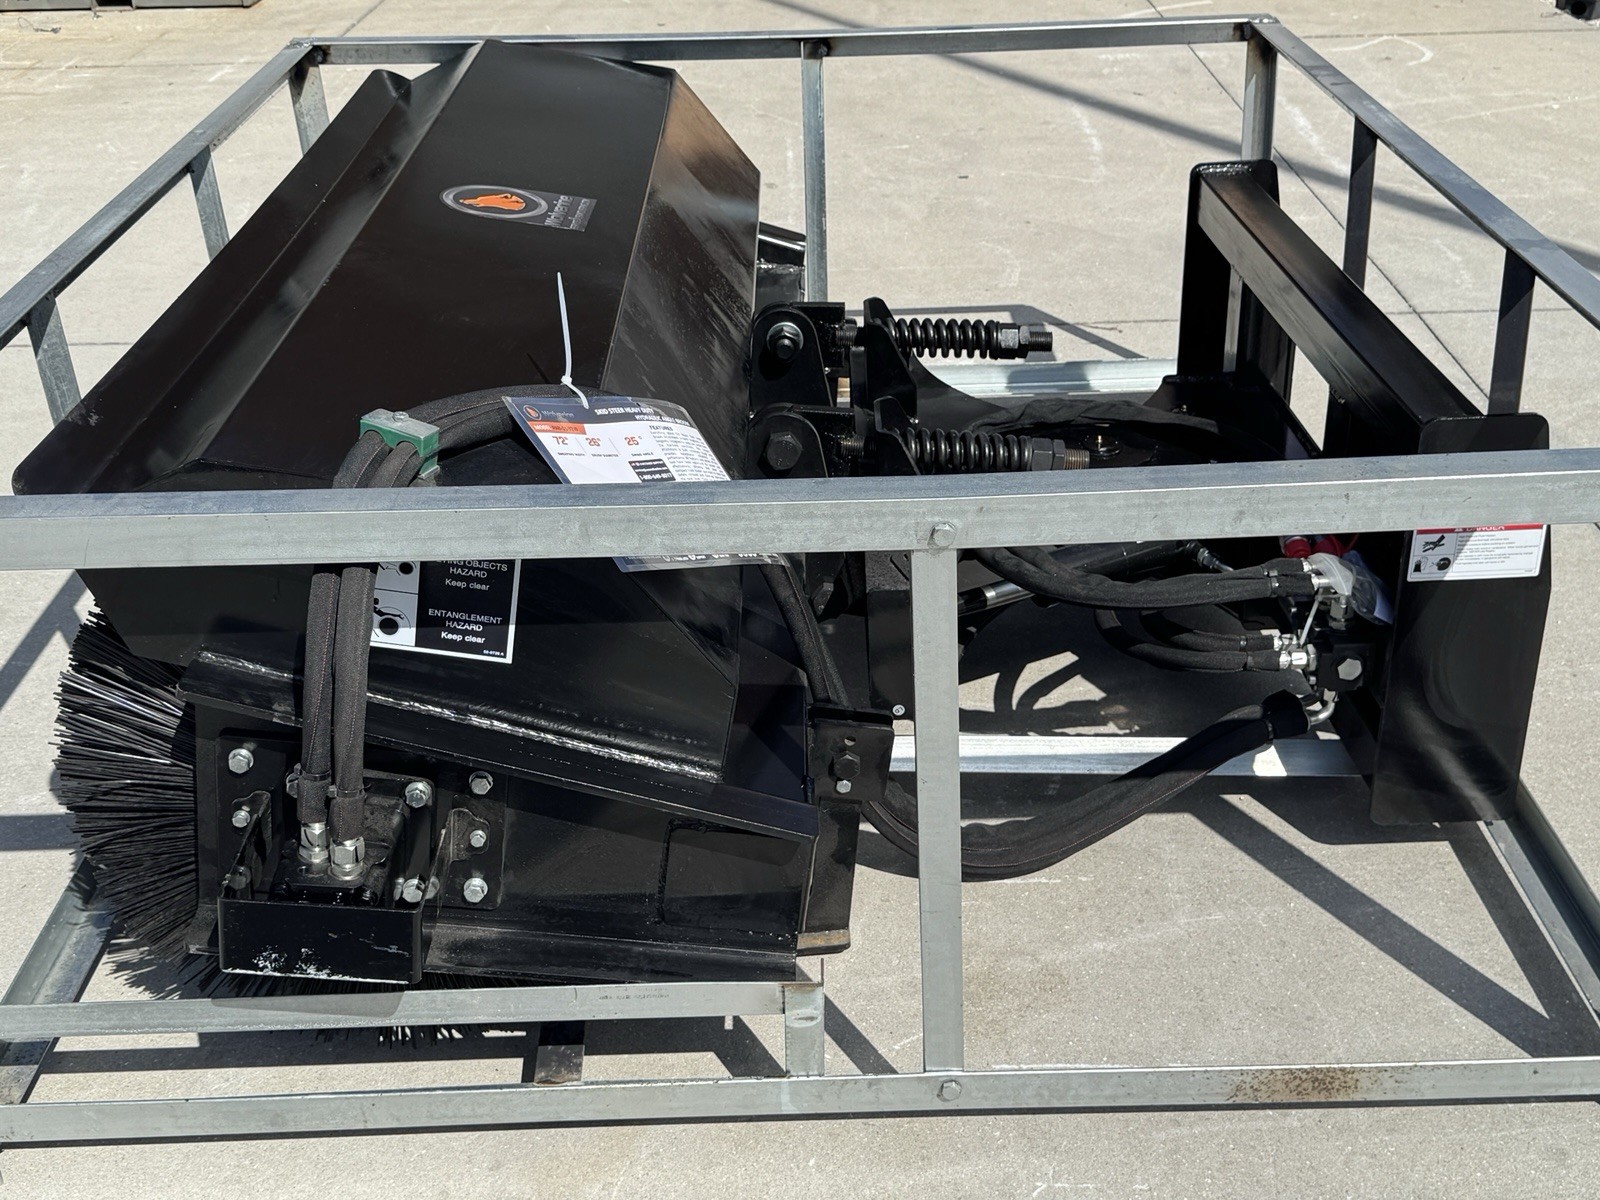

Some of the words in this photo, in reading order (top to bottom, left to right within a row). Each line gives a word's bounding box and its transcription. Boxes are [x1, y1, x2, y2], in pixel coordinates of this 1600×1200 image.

[594, 408, 609, 416] SKID
[608, 407, 625, 415] STEER
[465, 559, 508, 572] OBJECTS
[449, 567, 488, 578] HAZARD
[445, 578, 467, 588] Keep
[469, 582, 490, 591] clear
[428, 608, 503, 624] ENTANGLEMENT
[445, 620, 483, 632] HAZARD
[441, 631, 463, 642] Keep
[465, 635, 486, 644] clear
